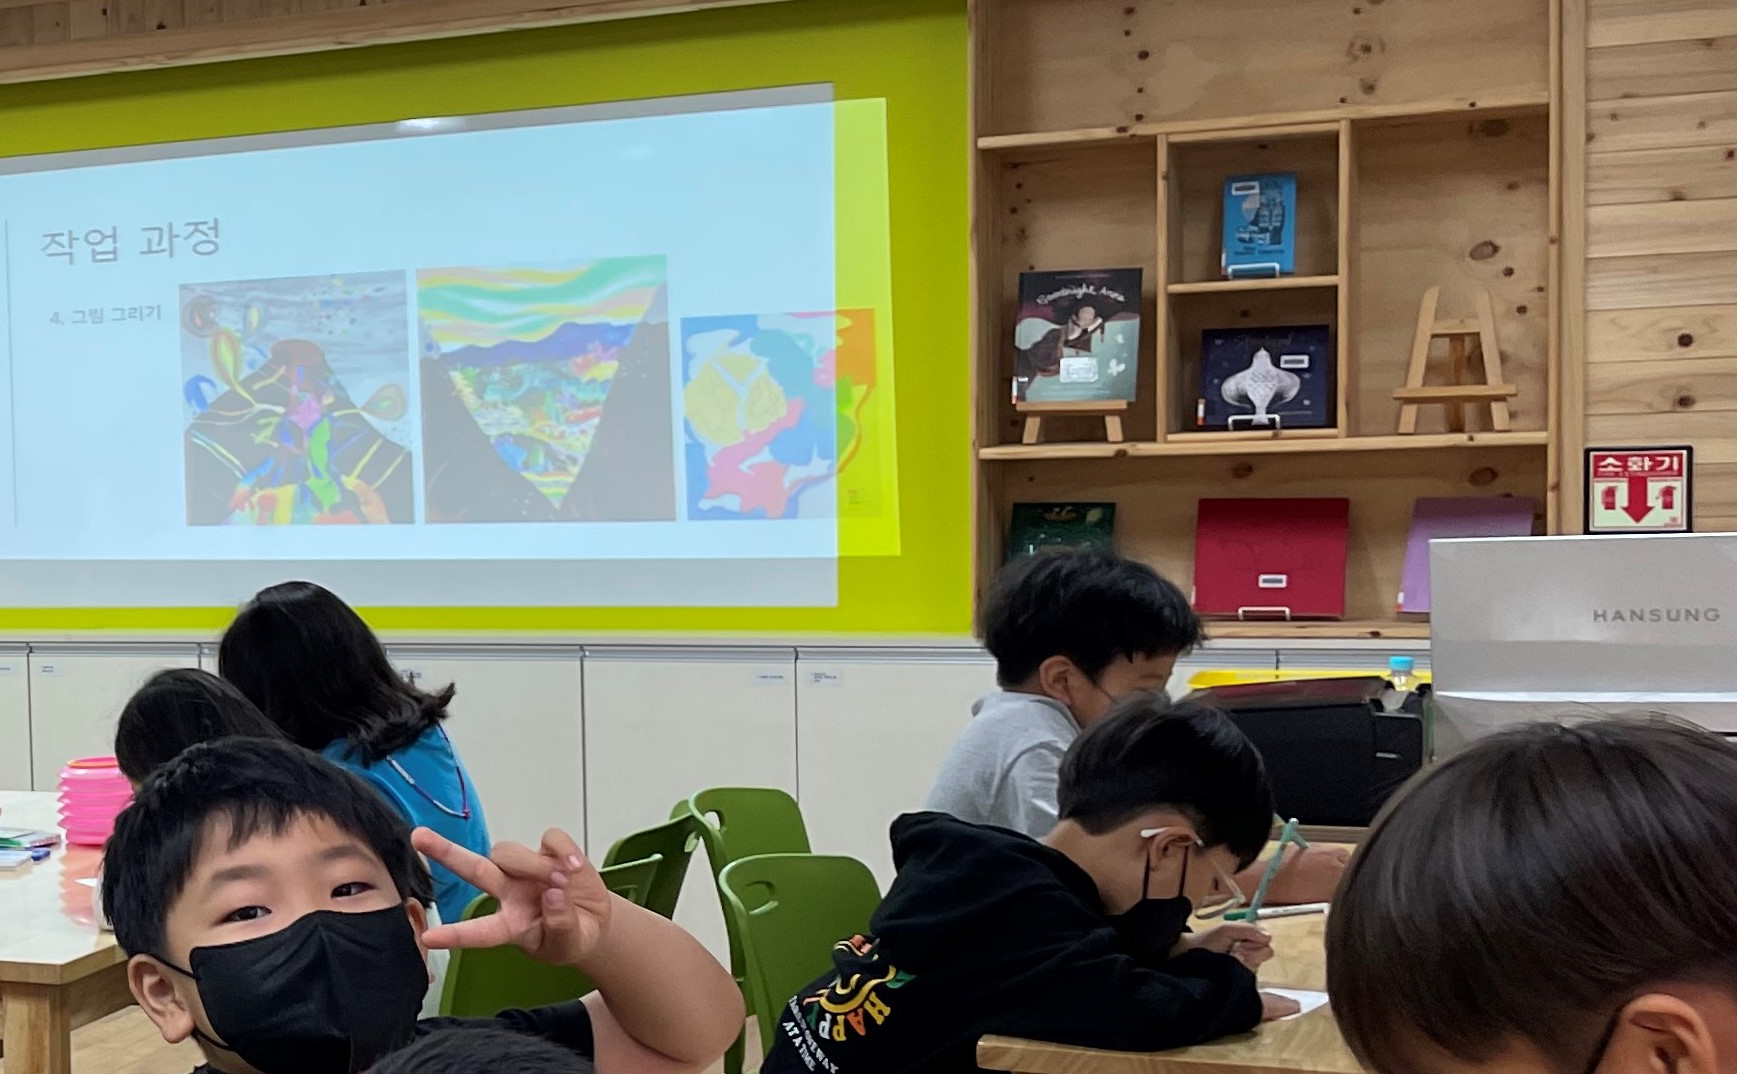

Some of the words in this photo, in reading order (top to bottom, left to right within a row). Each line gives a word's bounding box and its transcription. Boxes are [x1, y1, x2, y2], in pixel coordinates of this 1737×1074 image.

[41, 226, 118, 265] 작업
[139, 217, 220, 258] 과정
[71, 307, 105, 325] 그림
[111, 304, 162, 322] 그리기
[1597, 456, 1679, 472] 소화기
[1592, 607, 1721, 623] HANSUNG
